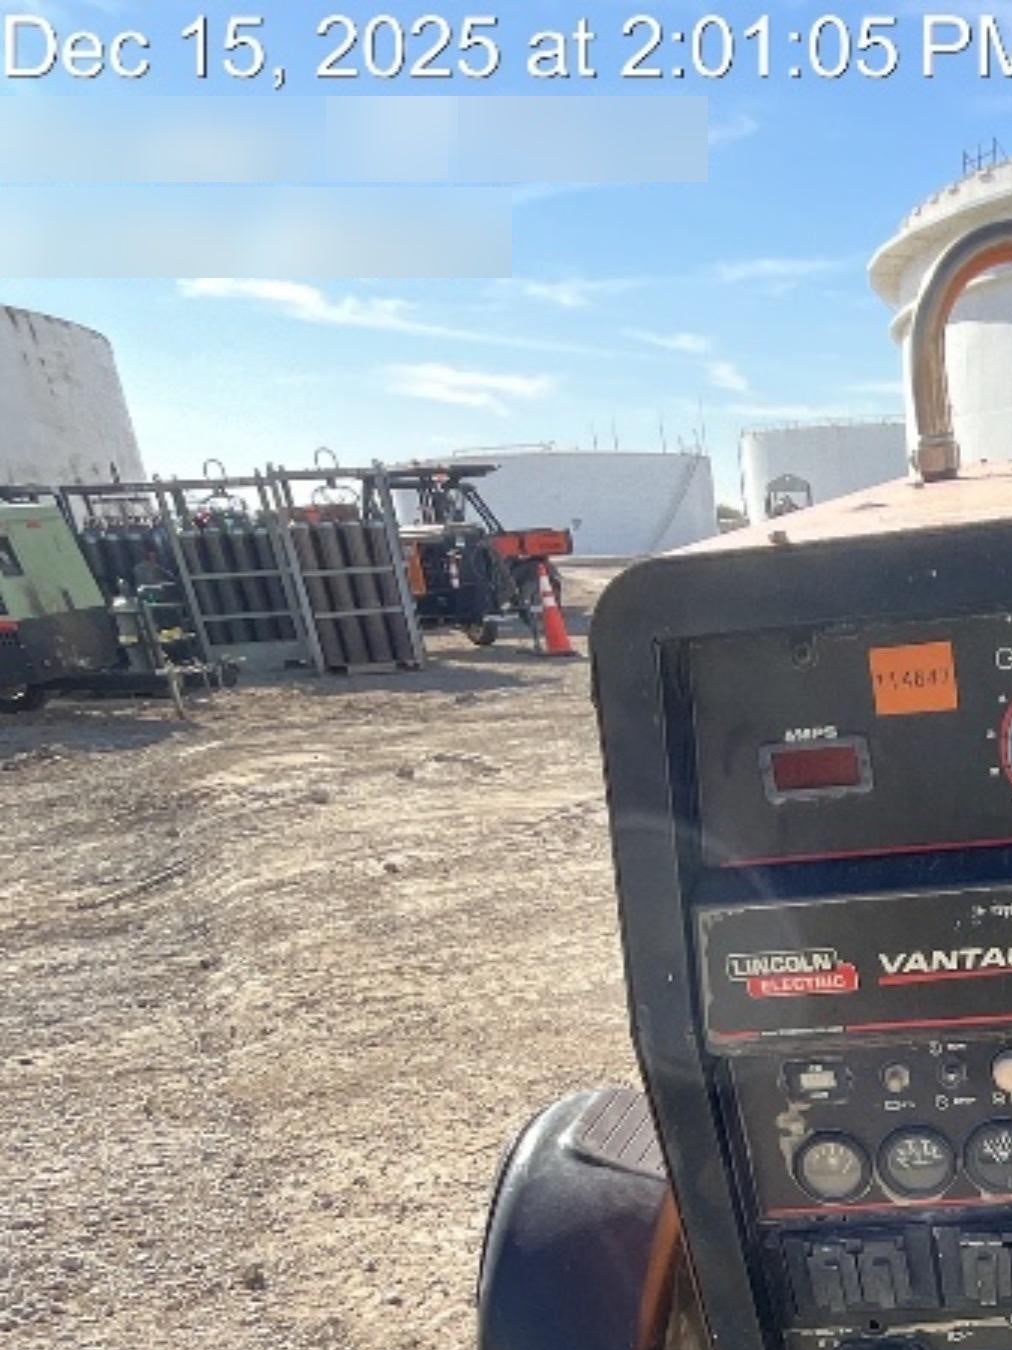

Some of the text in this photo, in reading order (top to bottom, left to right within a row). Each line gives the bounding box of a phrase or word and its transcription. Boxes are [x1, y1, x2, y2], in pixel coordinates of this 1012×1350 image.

[785, 725, 838, 742] AMPS
[733, 952, 832, 976] LINCOLN
[761, 975, 845, 992] ELECTRIC
